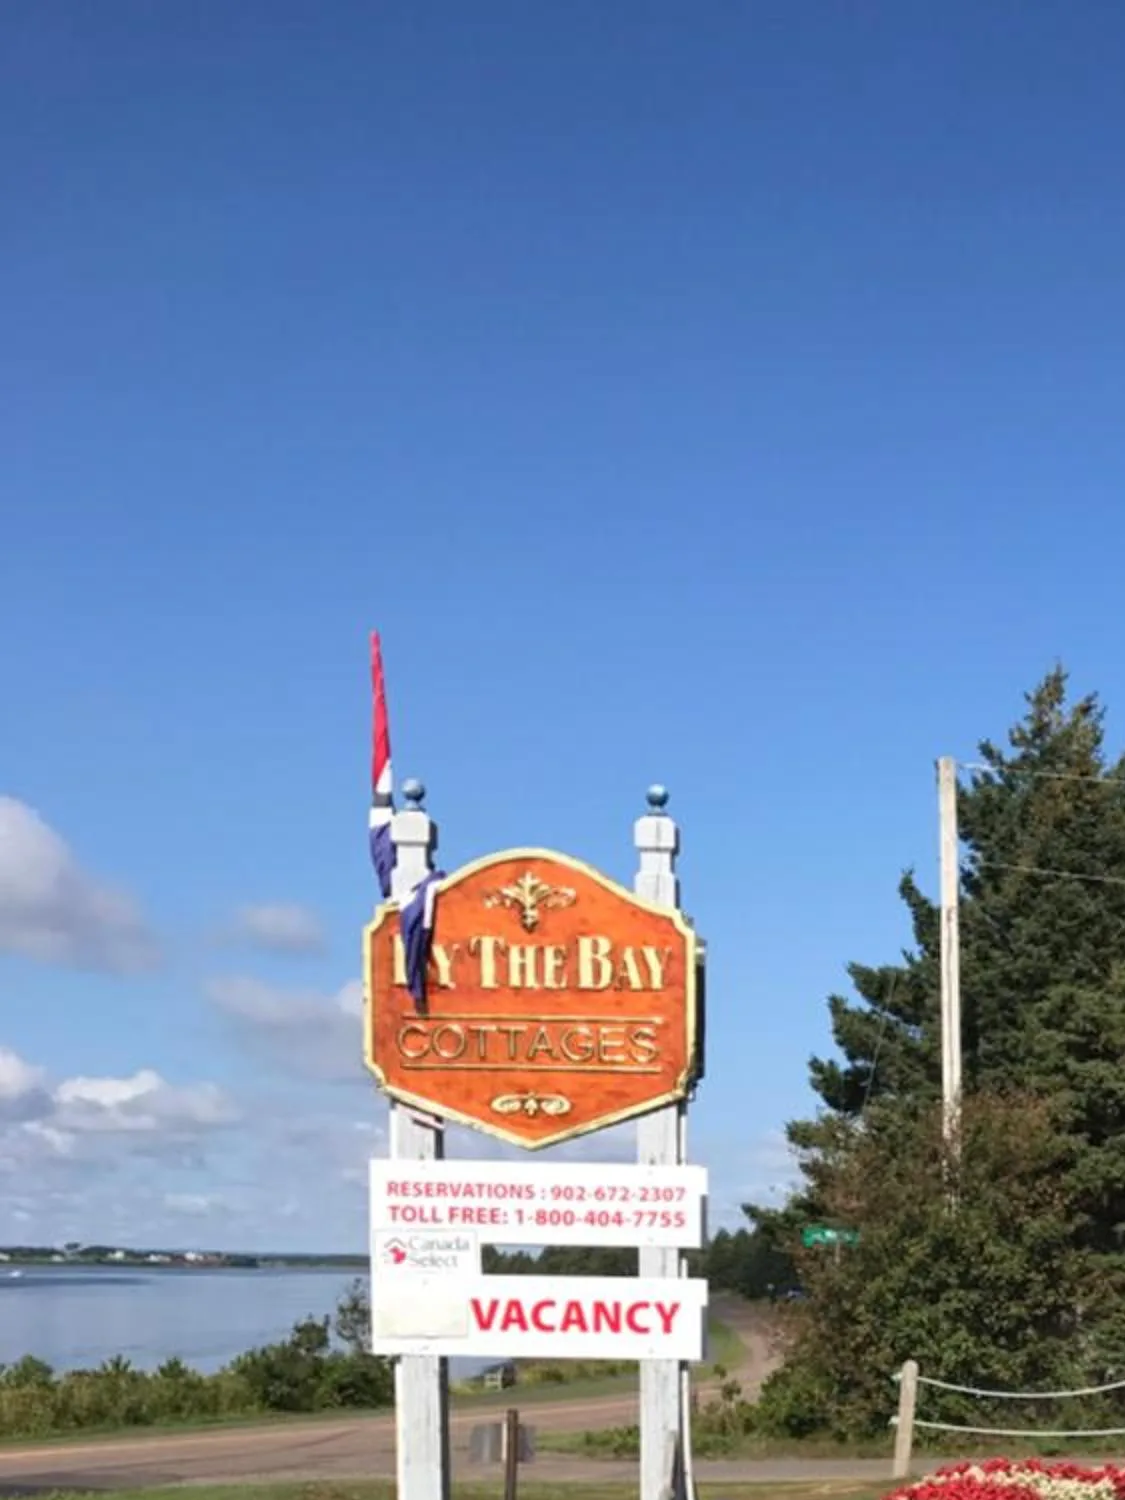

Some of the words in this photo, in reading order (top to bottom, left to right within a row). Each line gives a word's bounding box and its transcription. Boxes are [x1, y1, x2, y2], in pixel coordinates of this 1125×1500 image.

[470, 935, 568, 990] THE
[577, 935, 672, 991] BAY
[398, 1023, 659, 1064] COTTAGES
[550, 1185, 686, 1202] 902-672-2307
[387, 1204, 443, 1223] TOLL
[447, 1205, 509, 1225] FREE:
[515, 1209, 686, 1228] 1-800-404-7755
[408, 1235, 470, 1252] Canada
[408, 1254, 459, 1269] Select
[469, 1297, 681, 1335] VACANCY
